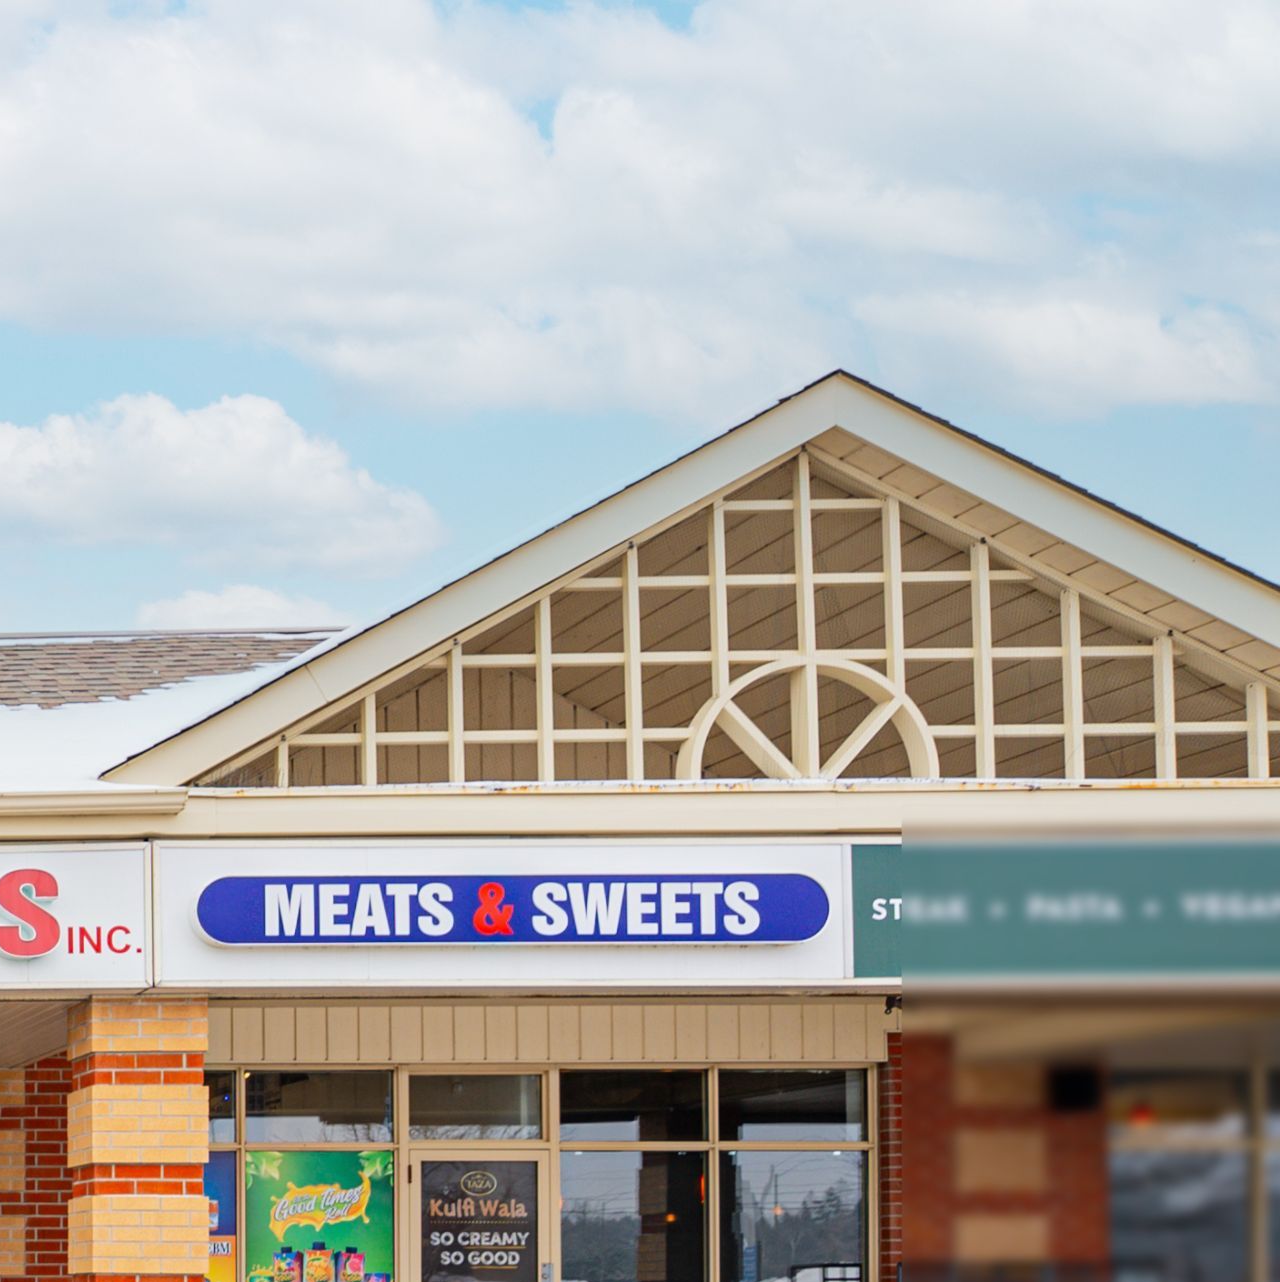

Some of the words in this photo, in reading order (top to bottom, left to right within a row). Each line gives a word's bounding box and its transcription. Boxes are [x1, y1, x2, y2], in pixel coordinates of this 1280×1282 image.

[264, 882, 454, 937] MEATS
[472, 881, 515, 936] &
[532, 881, 761, 937] SWEETS
[67, 925, 142, 954] INC.
[467, 1180, 492, 1189] TAZA
[274, 1196, 317, 1221] Good
[430, 1197, 476, 1217] Kulfi
[480, 1199, 528, 1217] Wala
[430, 1231, 455, 1246] SO
[457, 1231, 530, 1246] CREAMY
[440, 1251, 465, 1266] SO
[467, 1251, 520, 1266] GOOD
